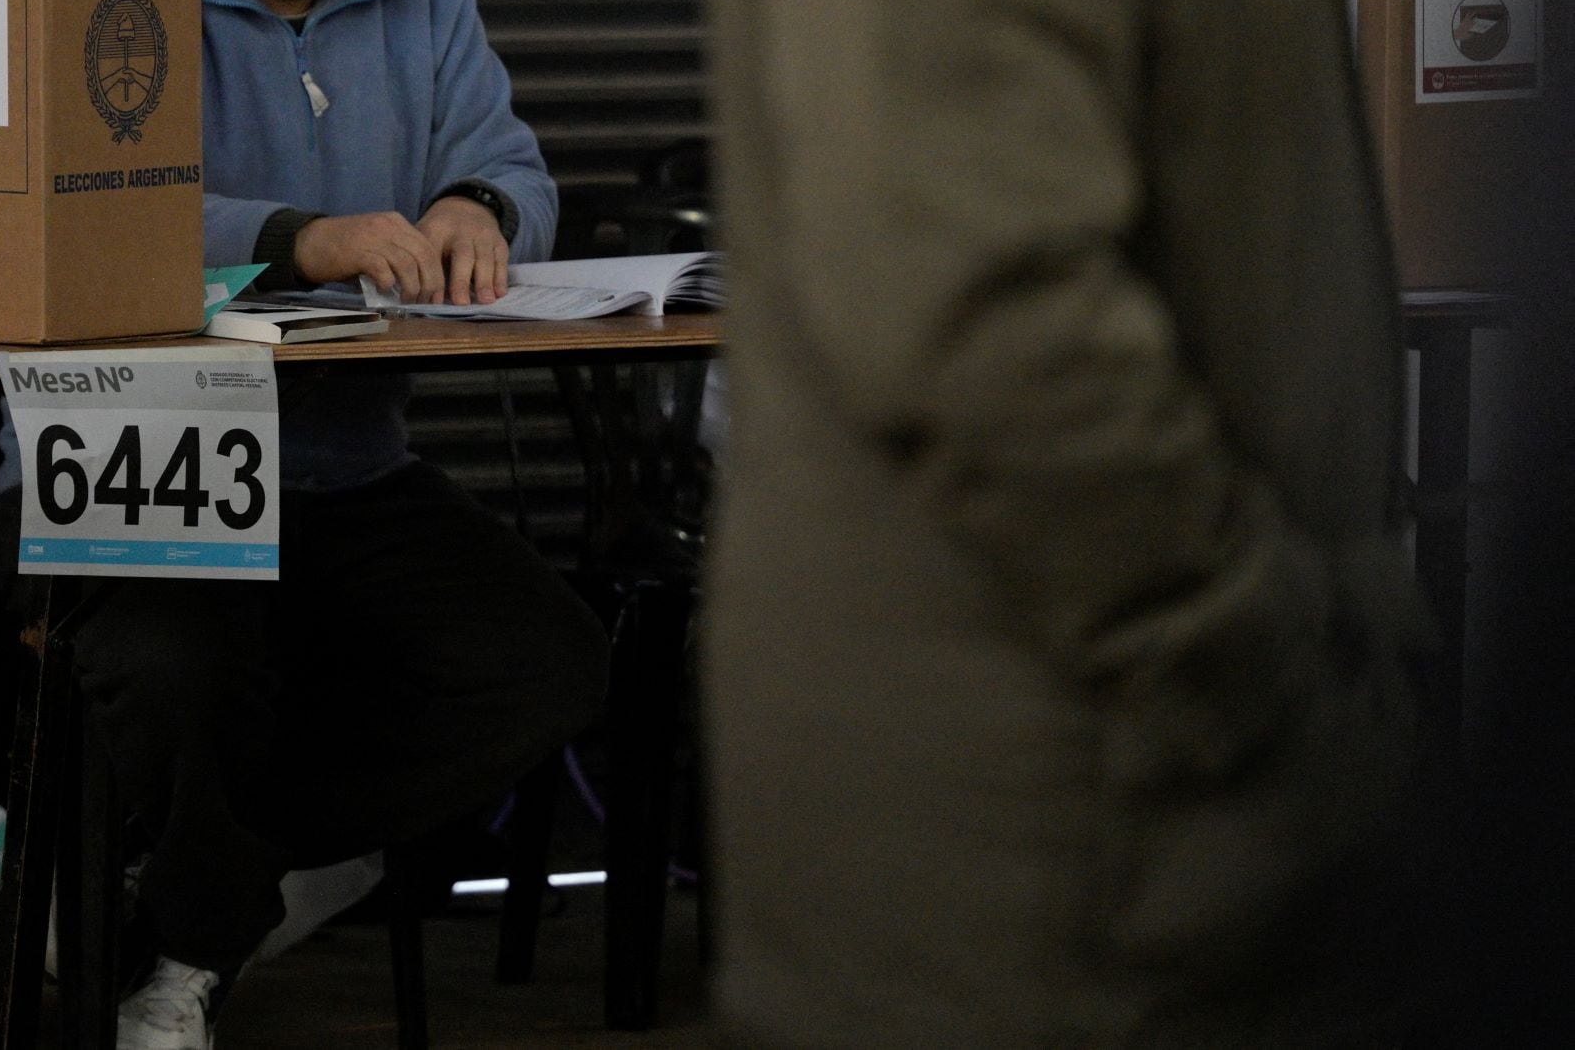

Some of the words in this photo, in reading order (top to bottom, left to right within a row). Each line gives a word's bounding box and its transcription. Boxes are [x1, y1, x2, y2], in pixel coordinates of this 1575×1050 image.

[54, 170, 125, 194] ELECCIONES
[128, 164, 200, 189] ARGENTINAS
[9, 366, 92, 393] Mesa
[36, 424, 266, 530] 6443
